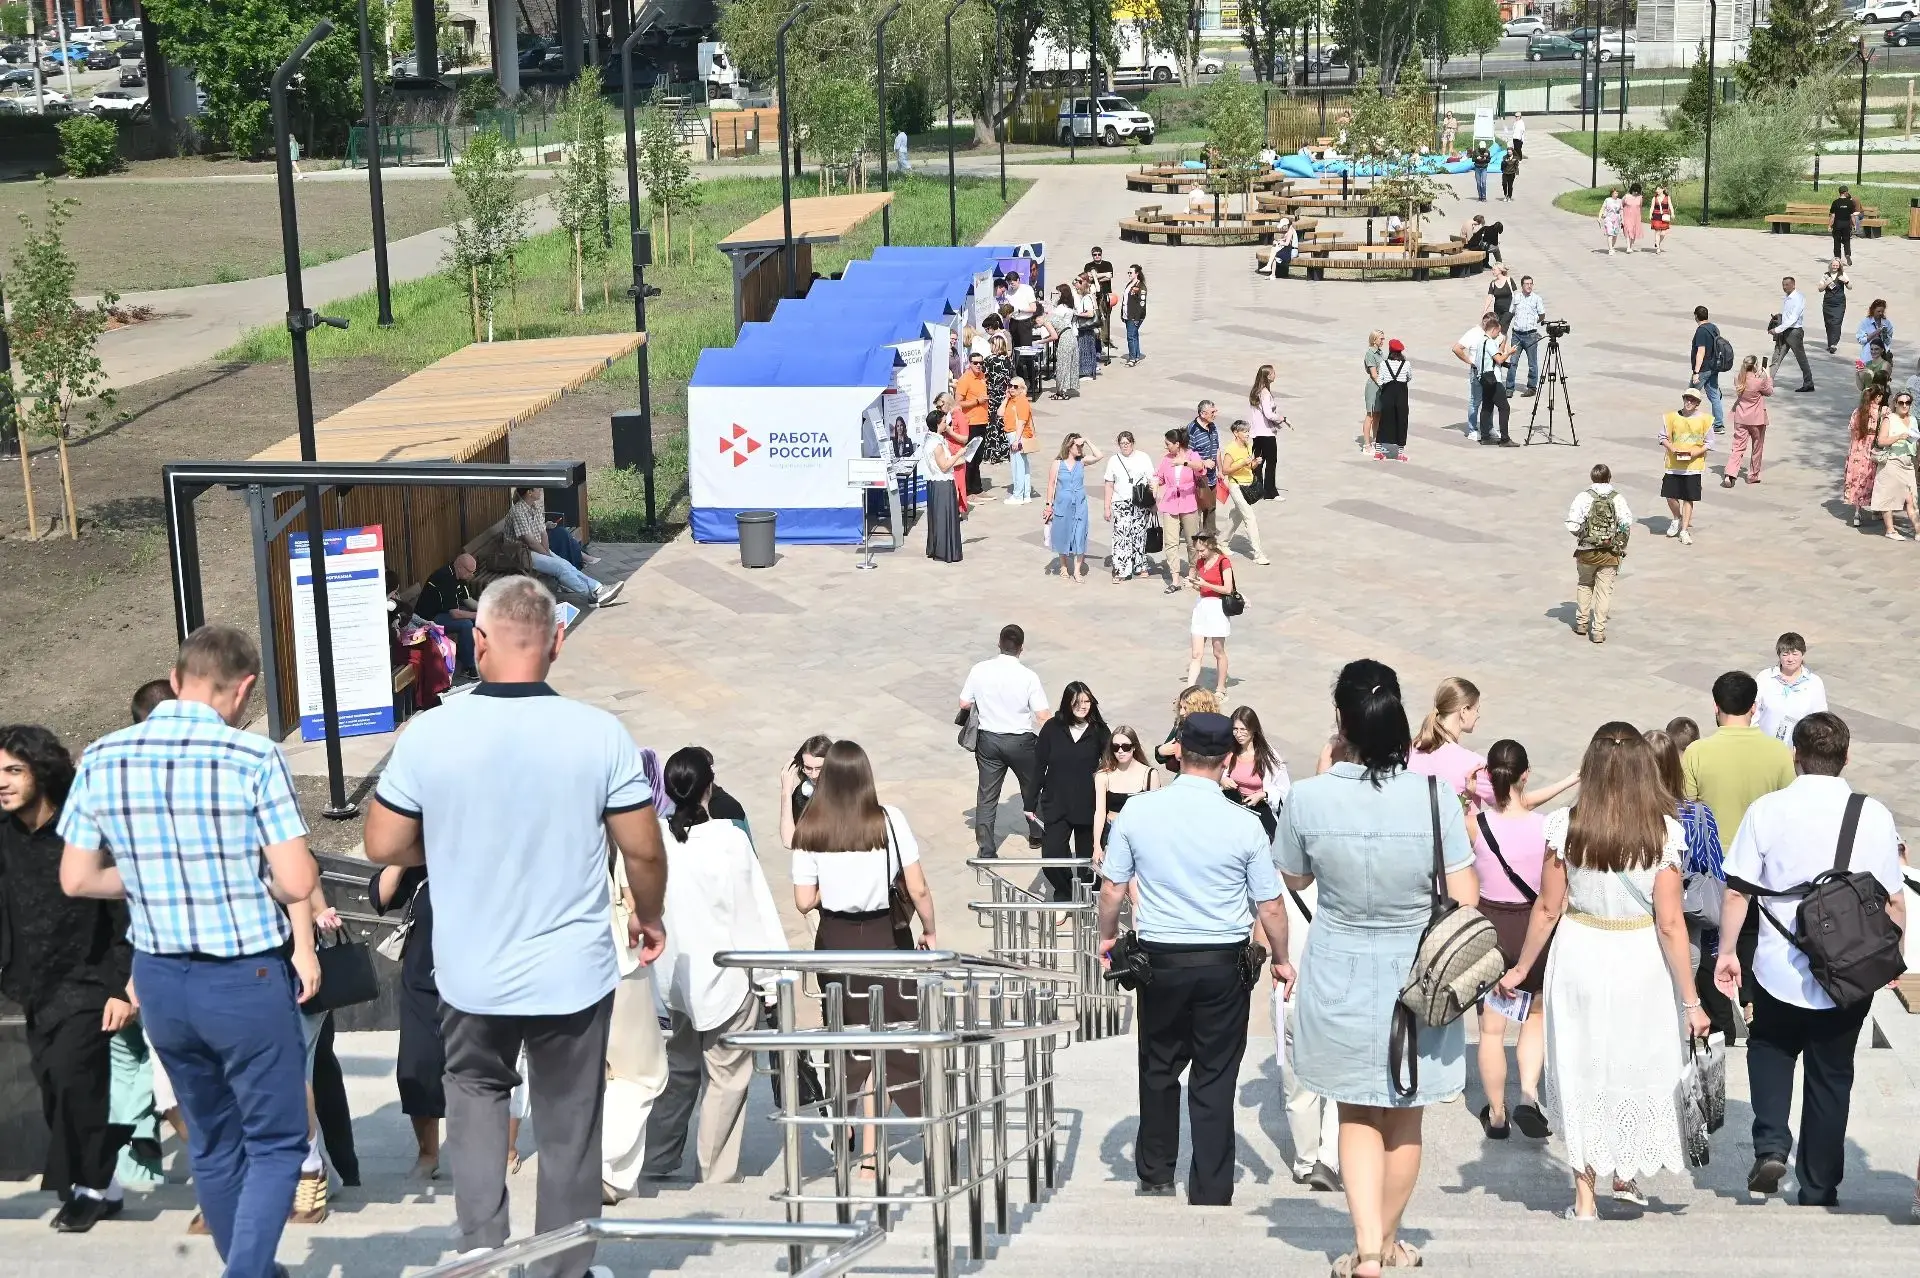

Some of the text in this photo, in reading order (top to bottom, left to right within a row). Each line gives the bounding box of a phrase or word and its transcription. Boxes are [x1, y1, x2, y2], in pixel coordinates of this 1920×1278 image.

[900, 349, 922, 357] РАБОТА
[904, 356, 923, 365] ОССИИ
[769, 432, 829, 444] РАБОТА
[769, 446, 833, 459] РОССИИ
